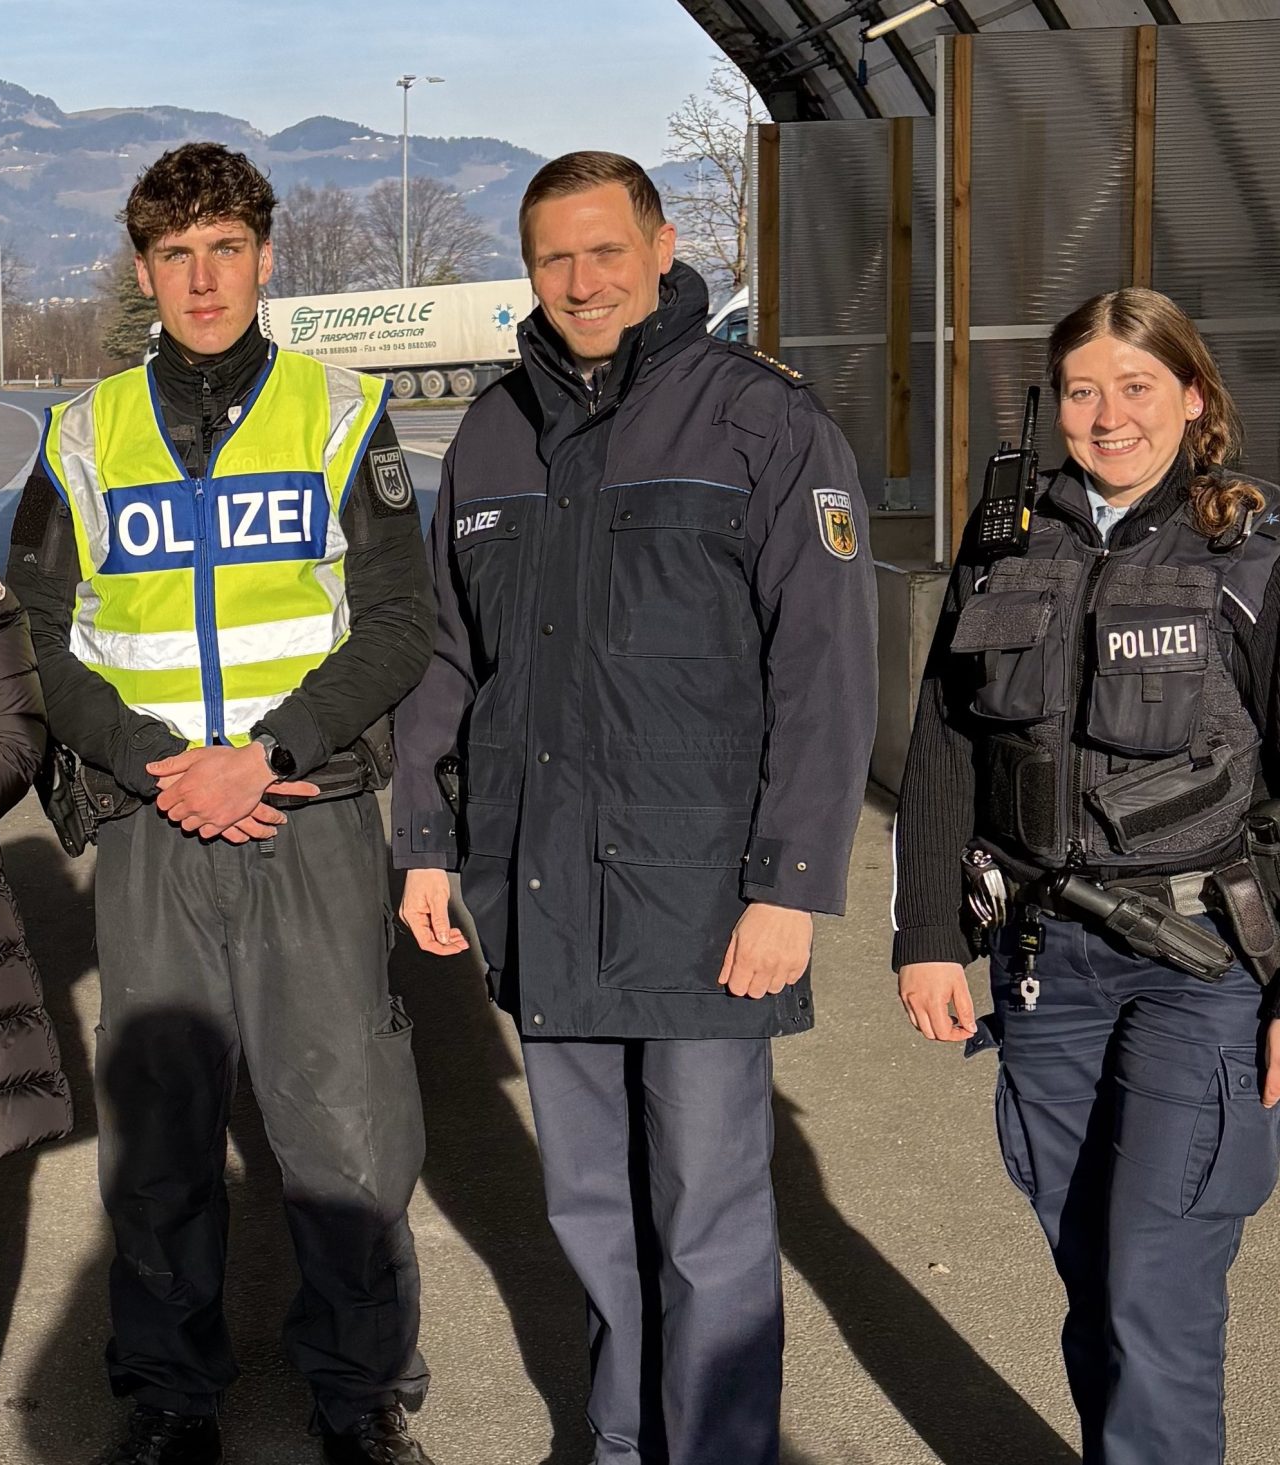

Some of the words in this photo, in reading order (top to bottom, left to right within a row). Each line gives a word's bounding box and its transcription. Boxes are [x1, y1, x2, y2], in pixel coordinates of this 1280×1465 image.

[324, 301, 435, 329] TIRAPELLE
[320, 331, 366, 343] TRASPORTI
[377, 328, 425, 339] LOGISTICA
[117, 489, 313, 556] OLIZEI
[1108, 624, 1197, 661] POLIZEI
